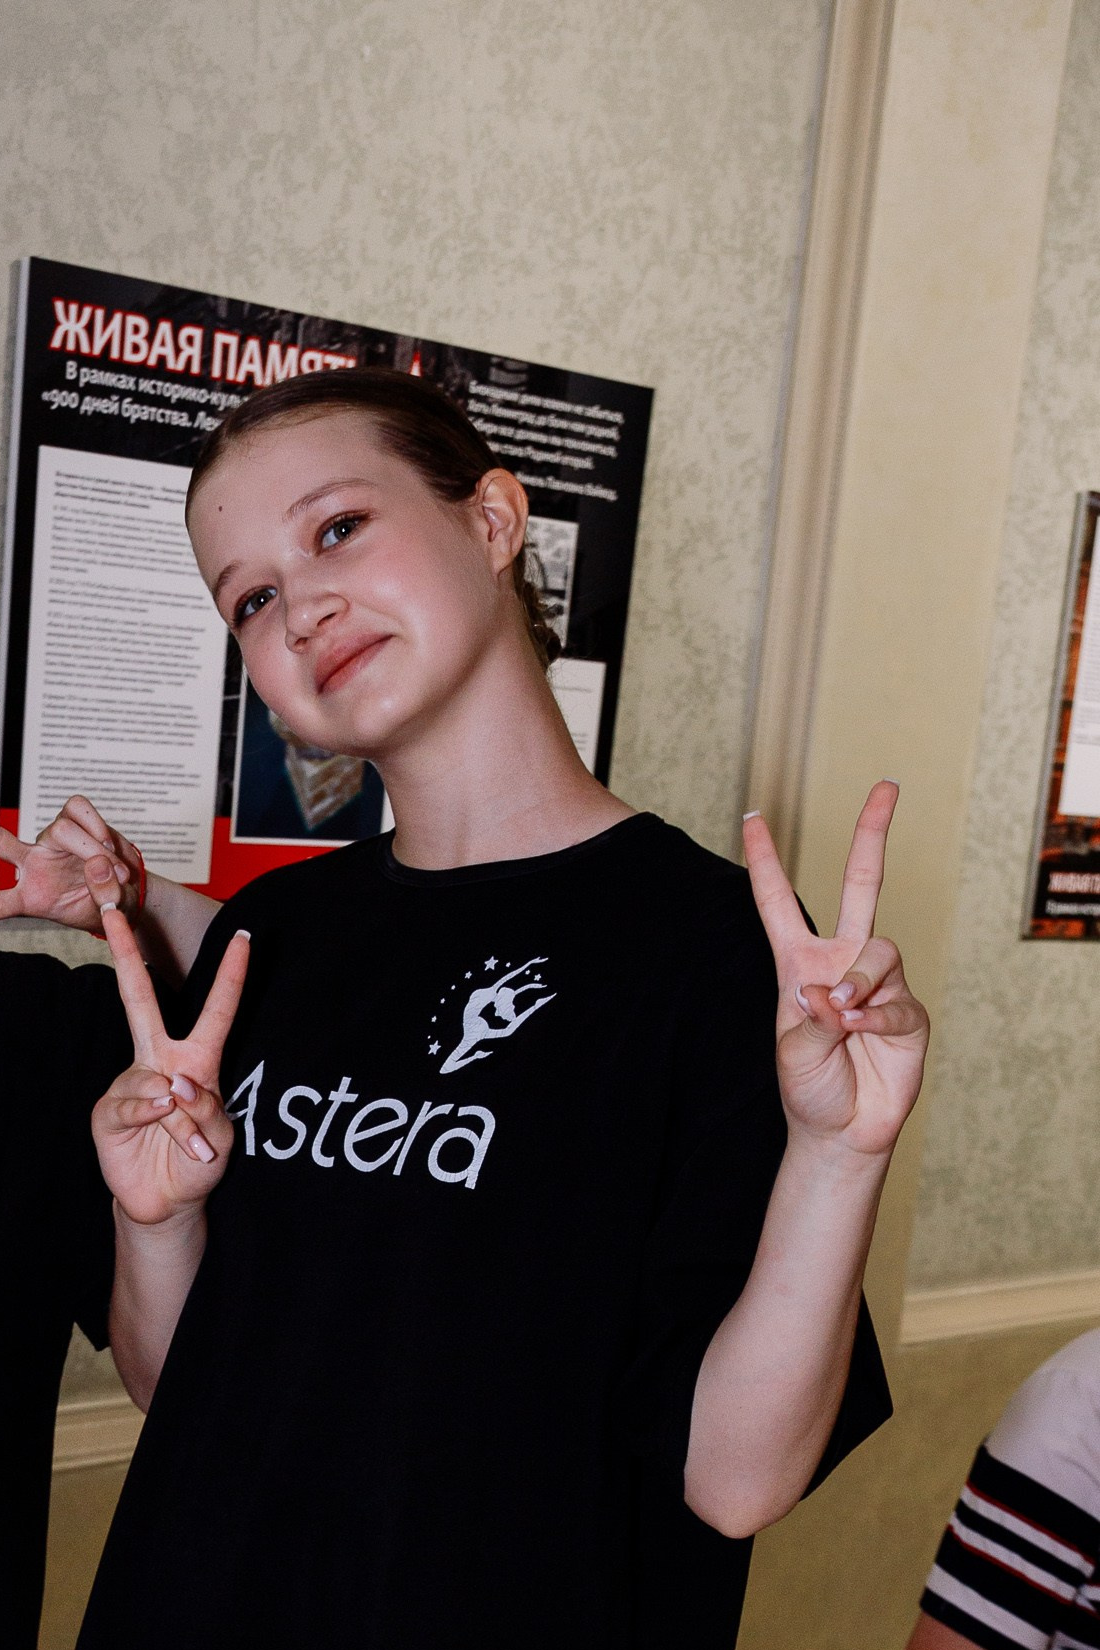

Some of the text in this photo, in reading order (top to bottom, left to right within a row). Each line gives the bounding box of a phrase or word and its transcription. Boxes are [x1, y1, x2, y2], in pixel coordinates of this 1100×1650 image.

[50, 298, 357, 389] ЖИВАЯ ПАМЯ
[65, 360, 78, 380] В
[79, 367, 137, 391] рамках
[80, 395, 120, 416] дней
[121, 398, 192, 428] братства.
[224, 1060, 496, 1190] Astera
